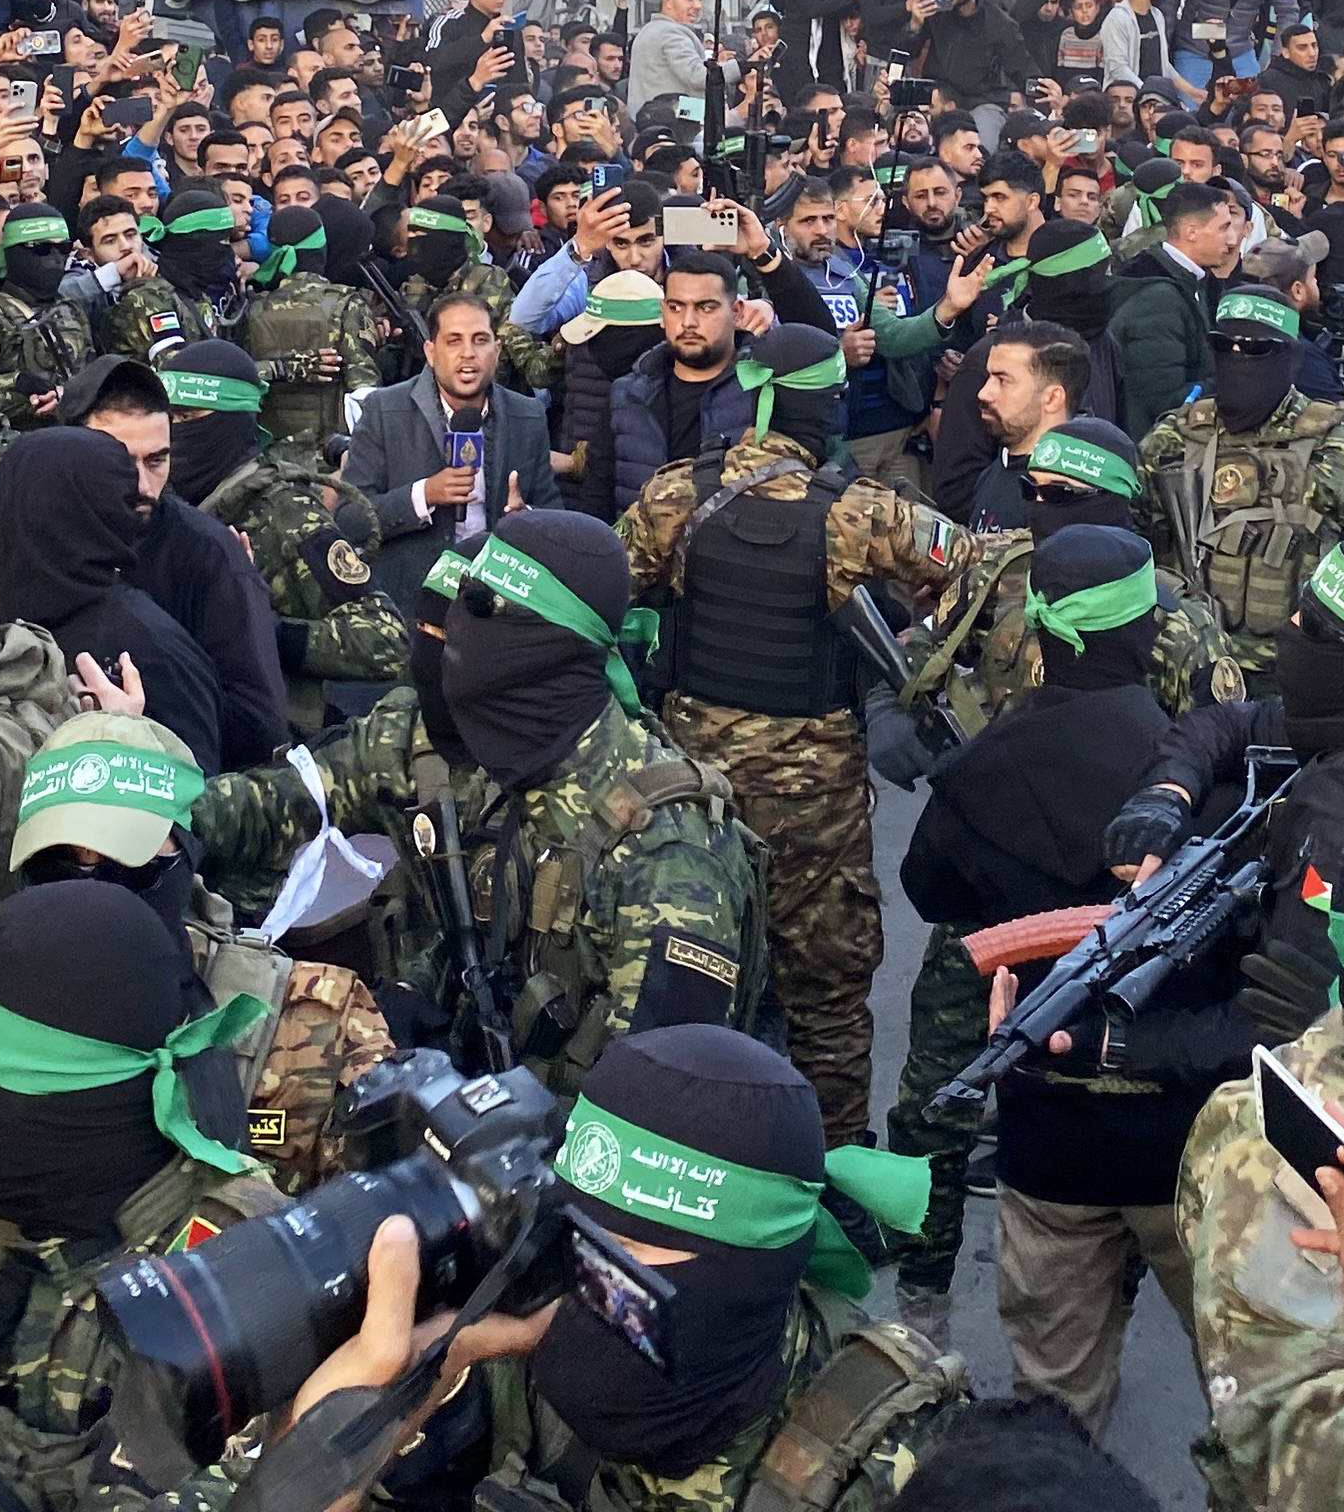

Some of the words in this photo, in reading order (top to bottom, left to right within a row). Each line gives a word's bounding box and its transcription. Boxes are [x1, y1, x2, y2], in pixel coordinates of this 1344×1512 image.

[827, 298, 856, 324] ESS
[112, 773, 175, 801] كتائب
[621, 1179, 721, 1222] كتائب
